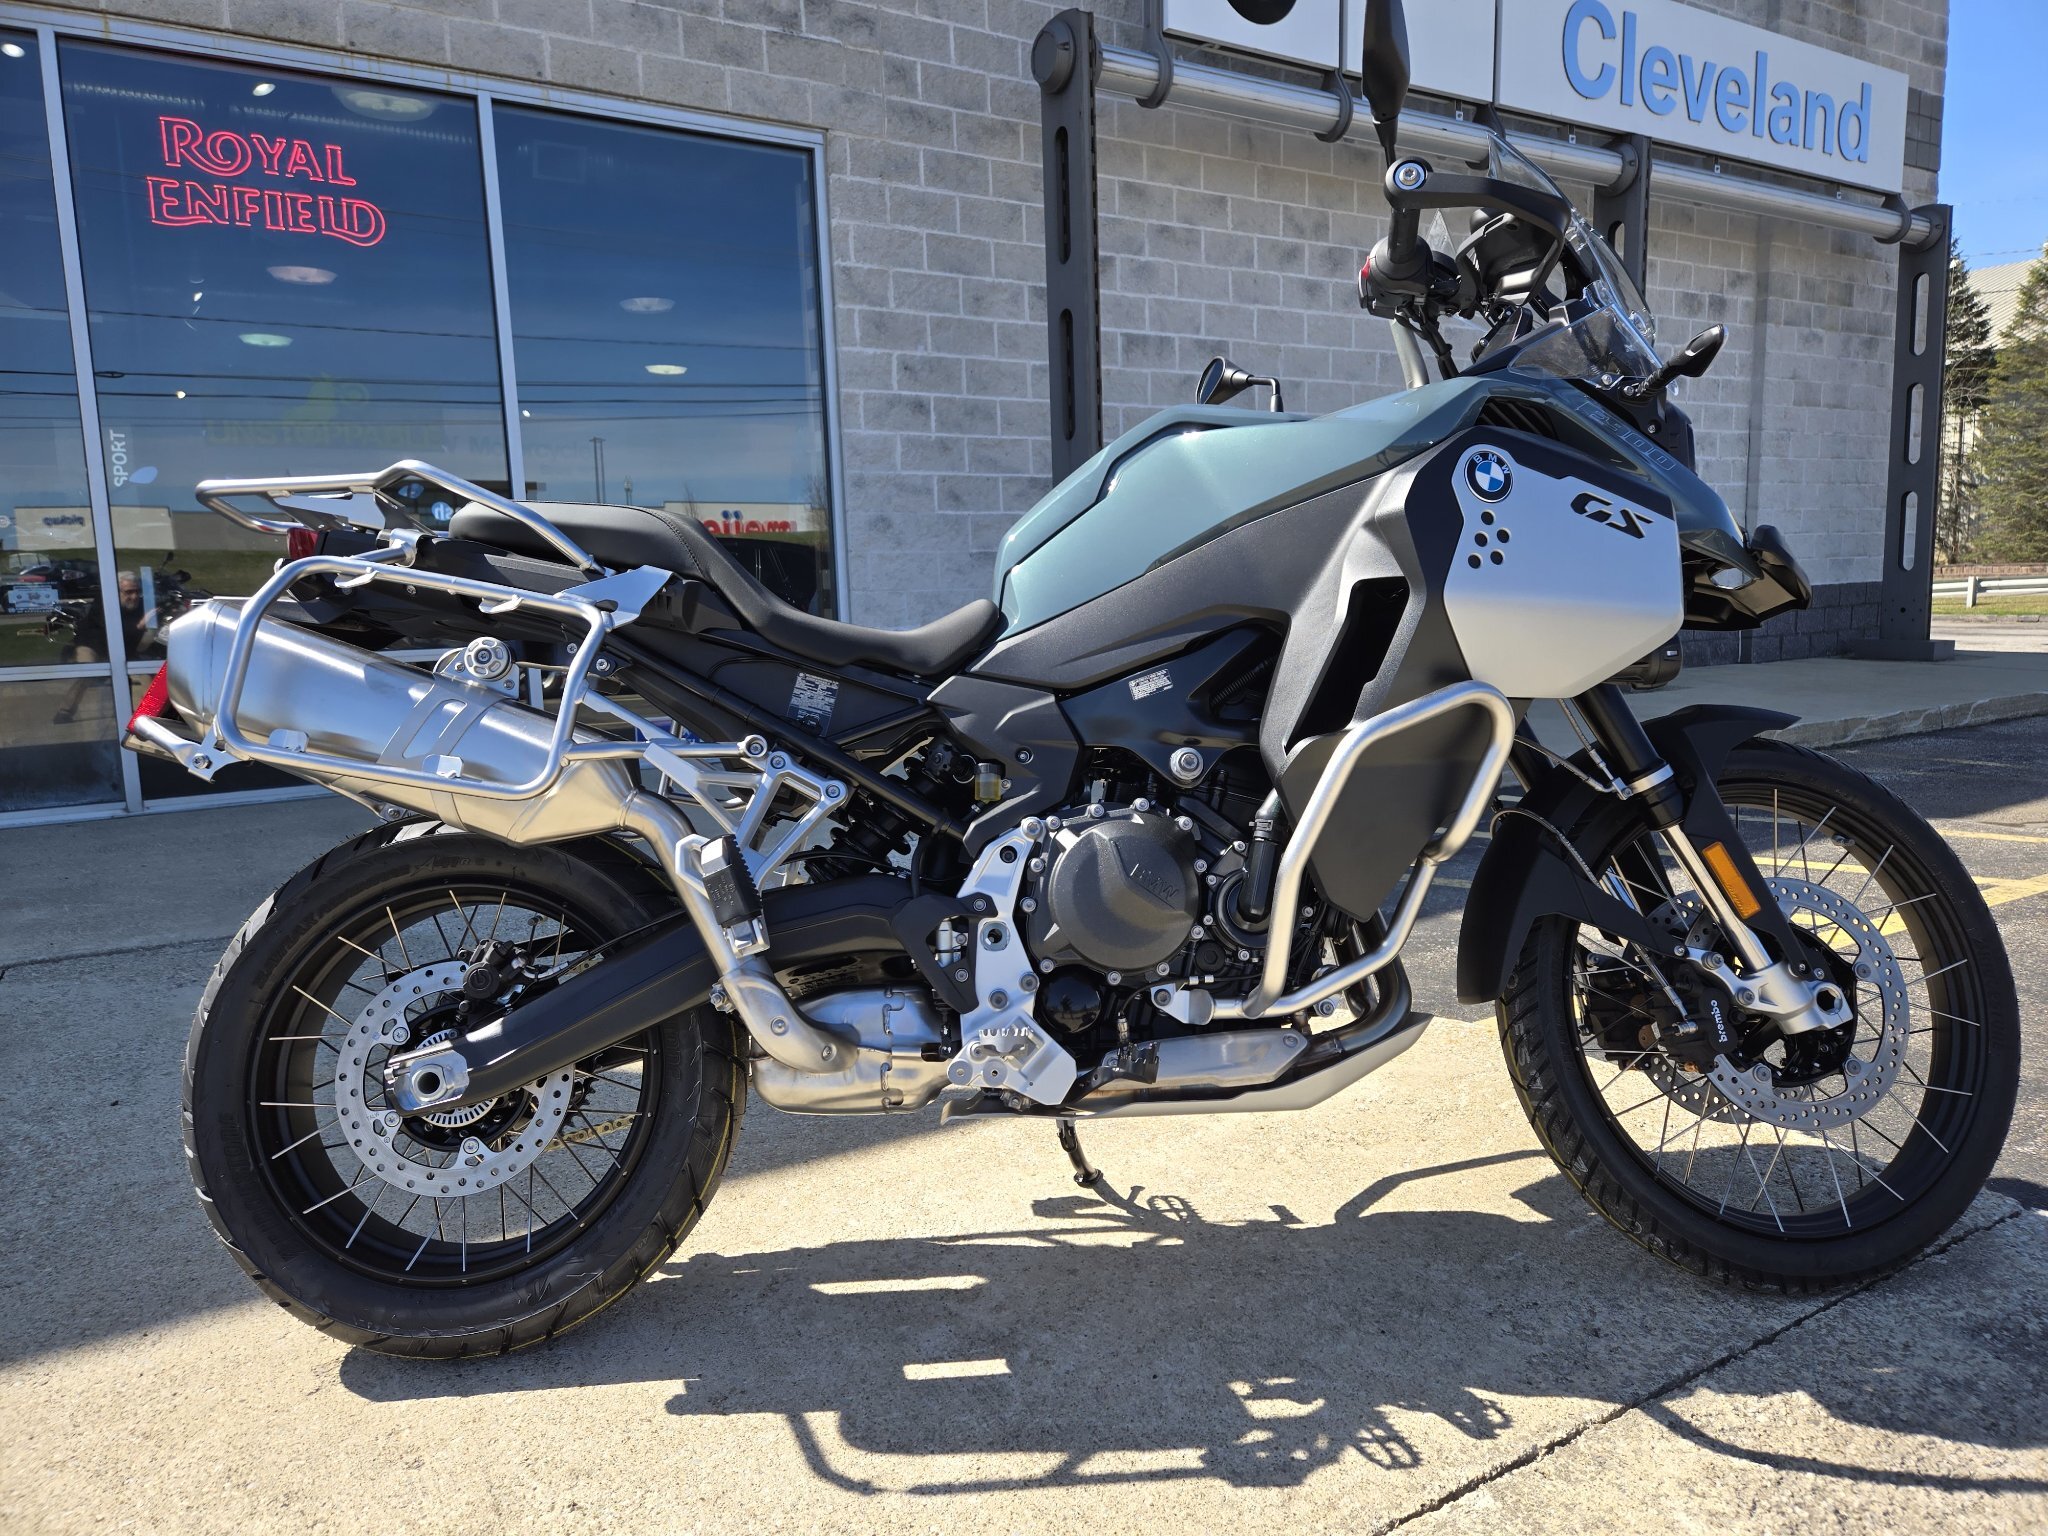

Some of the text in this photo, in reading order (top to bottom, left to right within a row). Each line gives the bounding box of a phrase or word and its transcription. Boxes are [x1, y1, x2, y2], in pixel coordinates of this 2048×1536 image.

[1562, 0, 1873, 164] Cleveland
[157, 115, 358, 187] ROYAL
[145, 174, 387, 247] ENFIELD
[109, 429, 128, 488] SPORT
[1473, 452, 1511, 476] BMW
[1569, 491, 1655, 540] GS
[1710, 999, 1729, 1043] brembo
